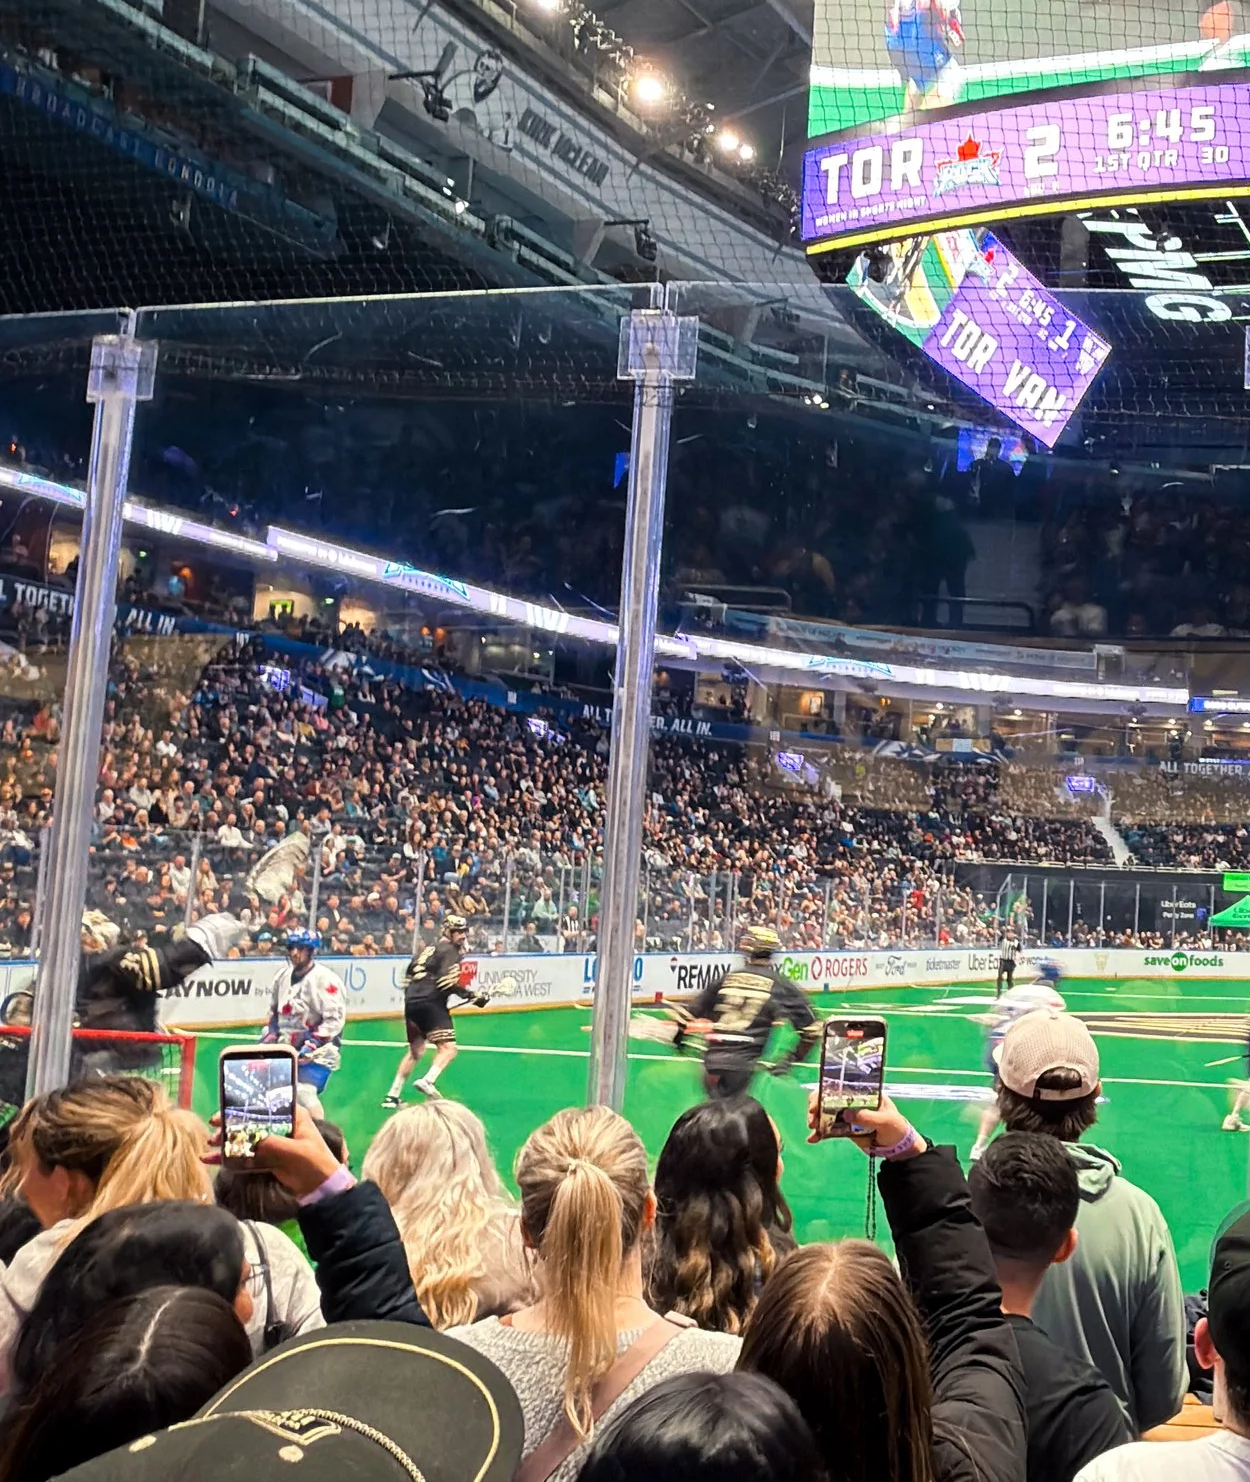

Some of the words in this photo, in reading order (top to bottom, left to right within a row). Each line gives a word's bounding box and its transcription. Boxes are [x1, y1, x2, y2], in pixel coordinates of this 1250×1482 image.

[1107, 106, 1216, 149] 6:45
[1024, 123, 1061, 179] 2
[1093, 153, 1132, 174] 1ST
[1137, 148, 1180, 171] QTR
[1200, 145, 1230, 164] 30
[820, 137, 925, 205] TOR
[1078, 208, 1233, 322] PMG
[940, 307, 998, 374] TOR
[1002, 358, 1068, 428] VAN
[14, 581, 75, 616] TOGET
[671, 718, 693, 734] ALL
[1159, 760, 1179, 774] ALL
[825, 957, 868, 978] ROGERS
[926, 958, 961, 972] ticketmaster
[968, 953, 987, 970] Uber
[164, 978, 252, 999] AYNOW
[524, 982, 552, 996] WEST
